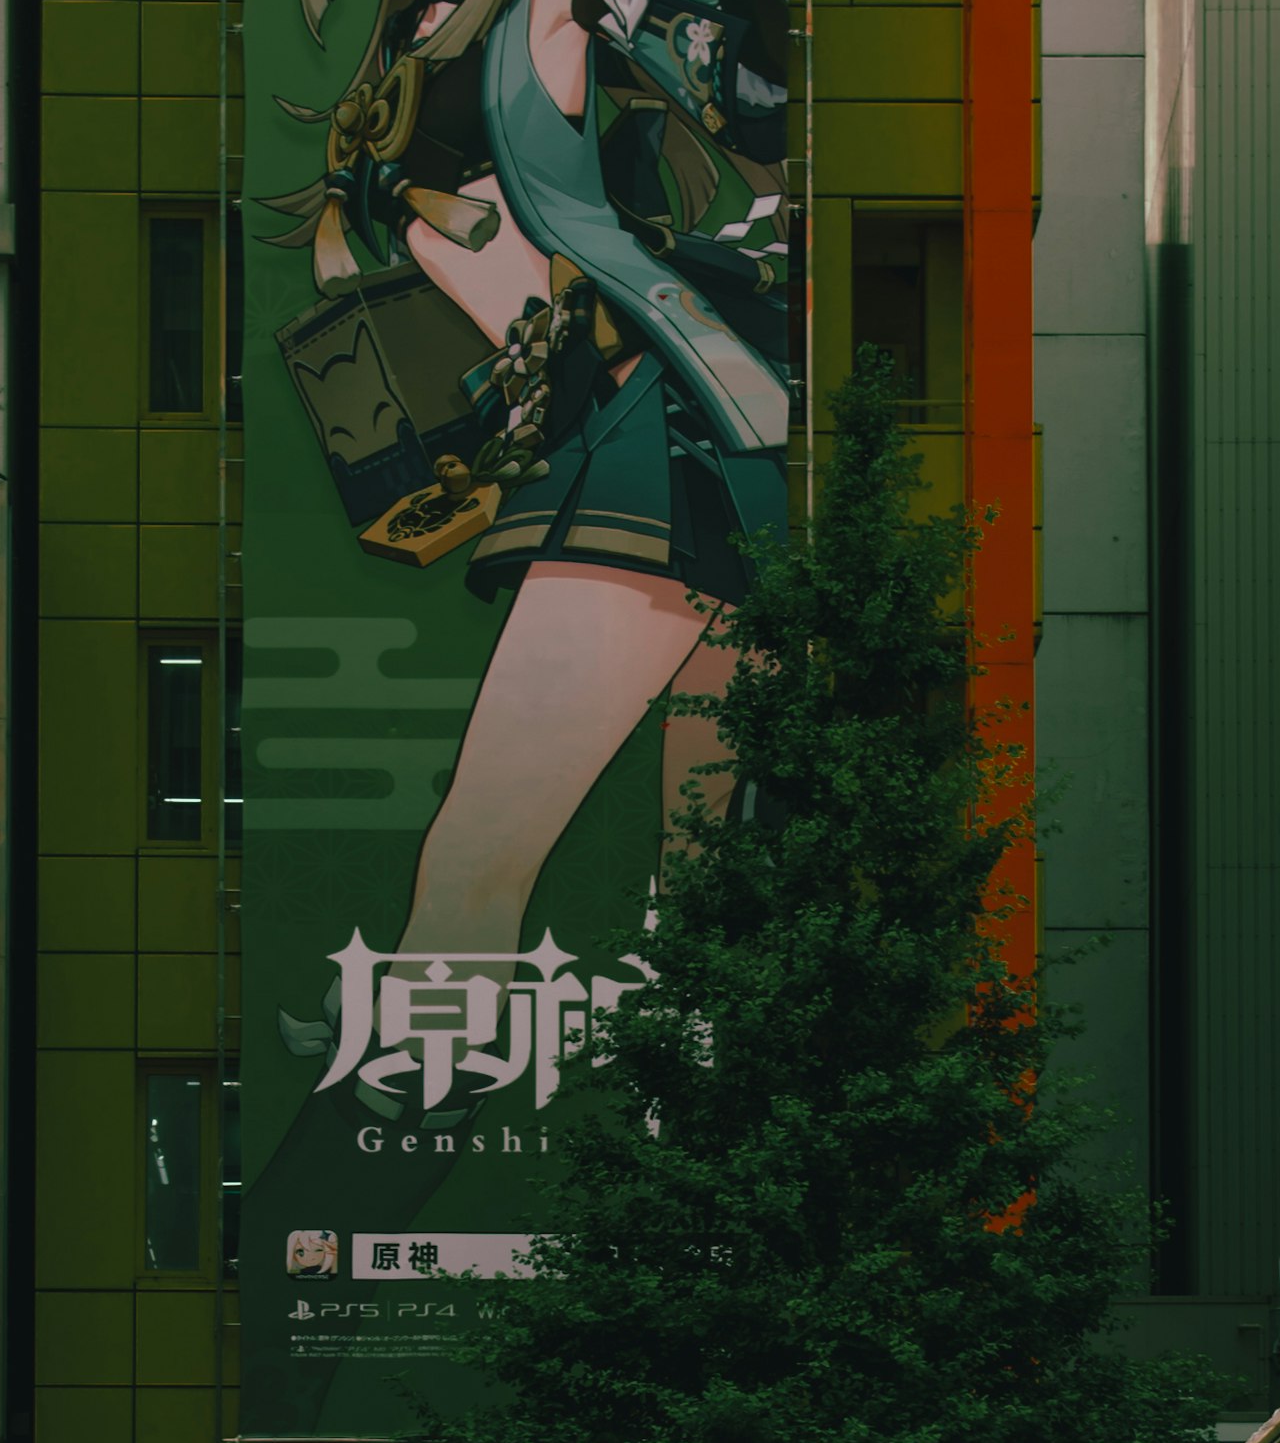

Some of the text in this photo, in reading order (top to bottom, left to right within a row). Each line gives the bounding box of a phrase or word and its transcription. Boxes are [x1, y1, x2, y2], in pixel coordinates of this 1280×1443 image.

[356, 1126, 551, 1154] Genshi
[371, 1241, 440, 1272] 原神
[320, 1301, 380, 1319] PS5
[397, 1301, 458, 1319] PS4
